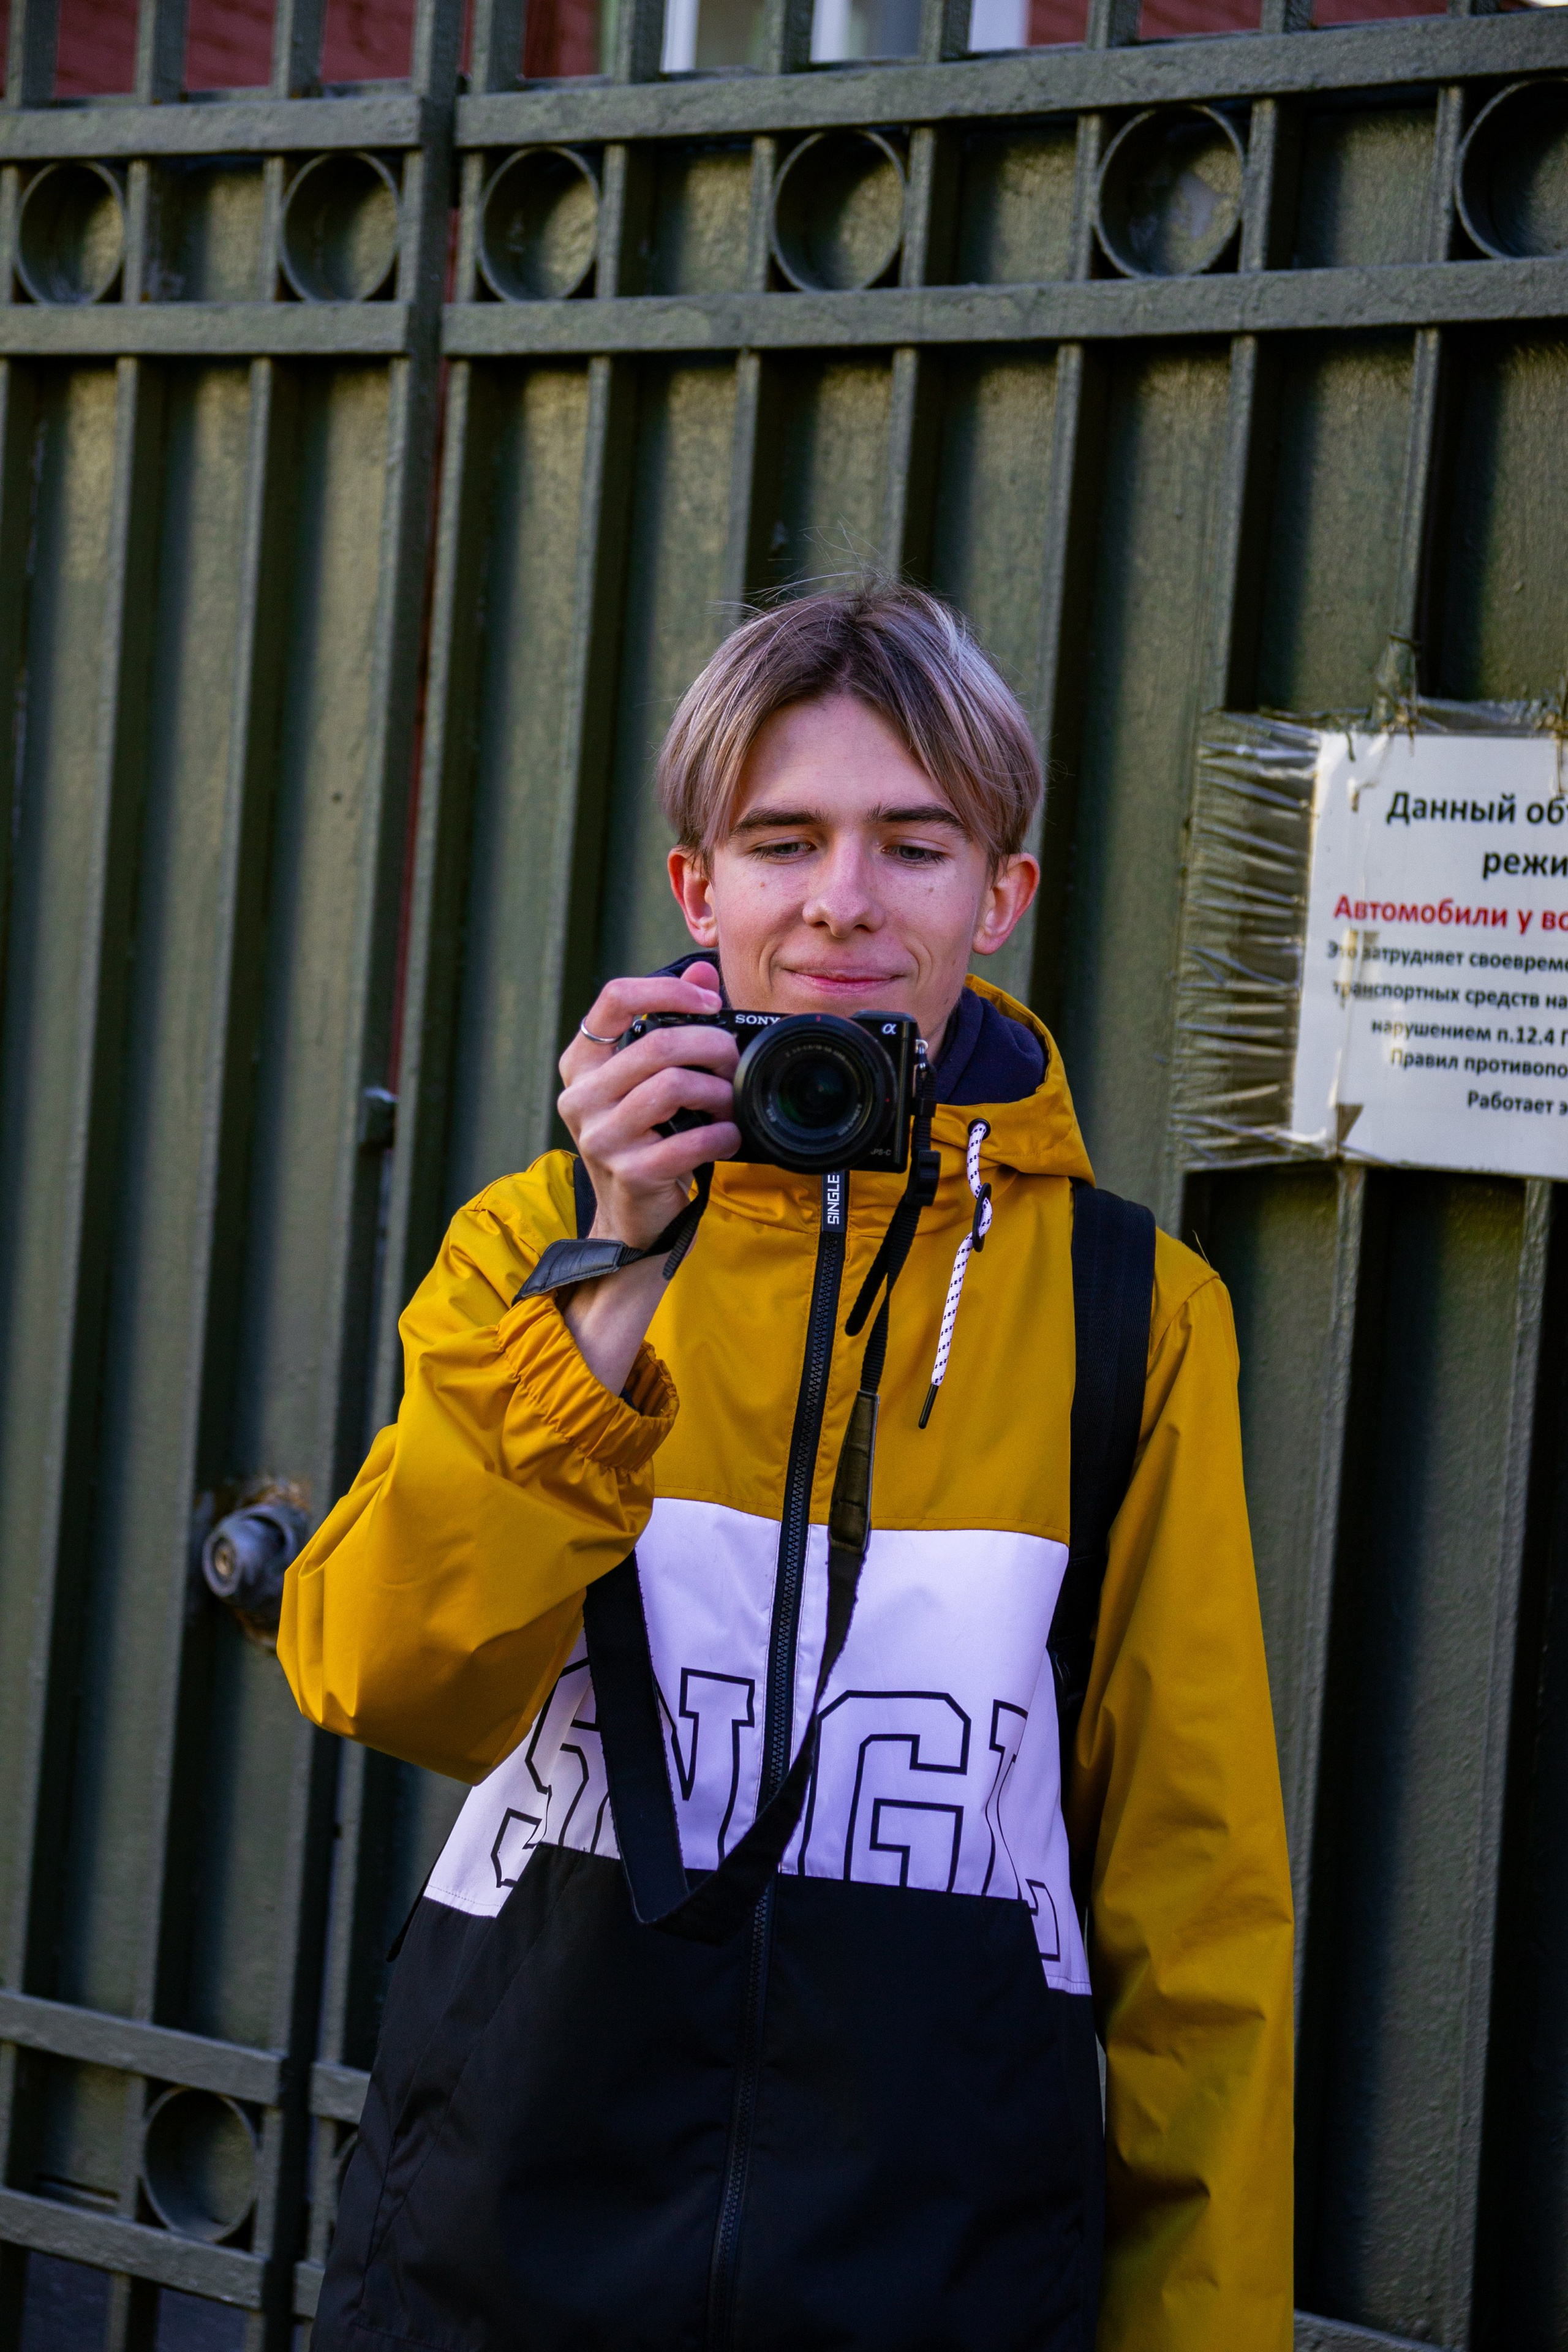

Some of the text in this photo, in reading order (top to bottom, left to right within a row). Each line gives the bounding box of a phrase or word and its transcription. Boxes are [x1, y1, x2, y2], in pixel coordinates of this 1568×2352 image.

[1387, 792, 1568, 826] Данный об
[1335, 895, 1507, 927] Автомобили
[1518, 909, 1533, 935] у
[1362, 946, 1463, 967] затрудняет
[1333, 981, 1459, 1004] транспортных
[1465, 989, 1539, 1009] средств
[735, 1014, 780, 1025] SONY
[1371, 1019, 1491, 1041] нарушением
[1497, 1026, 1555, 1046] п.12.4
[1390, 1049, 1568, 1078] Правил противопо
[1468, 1090, 1553, 1115] Работает
[827, 1174, 840, 1224] SINGLE
